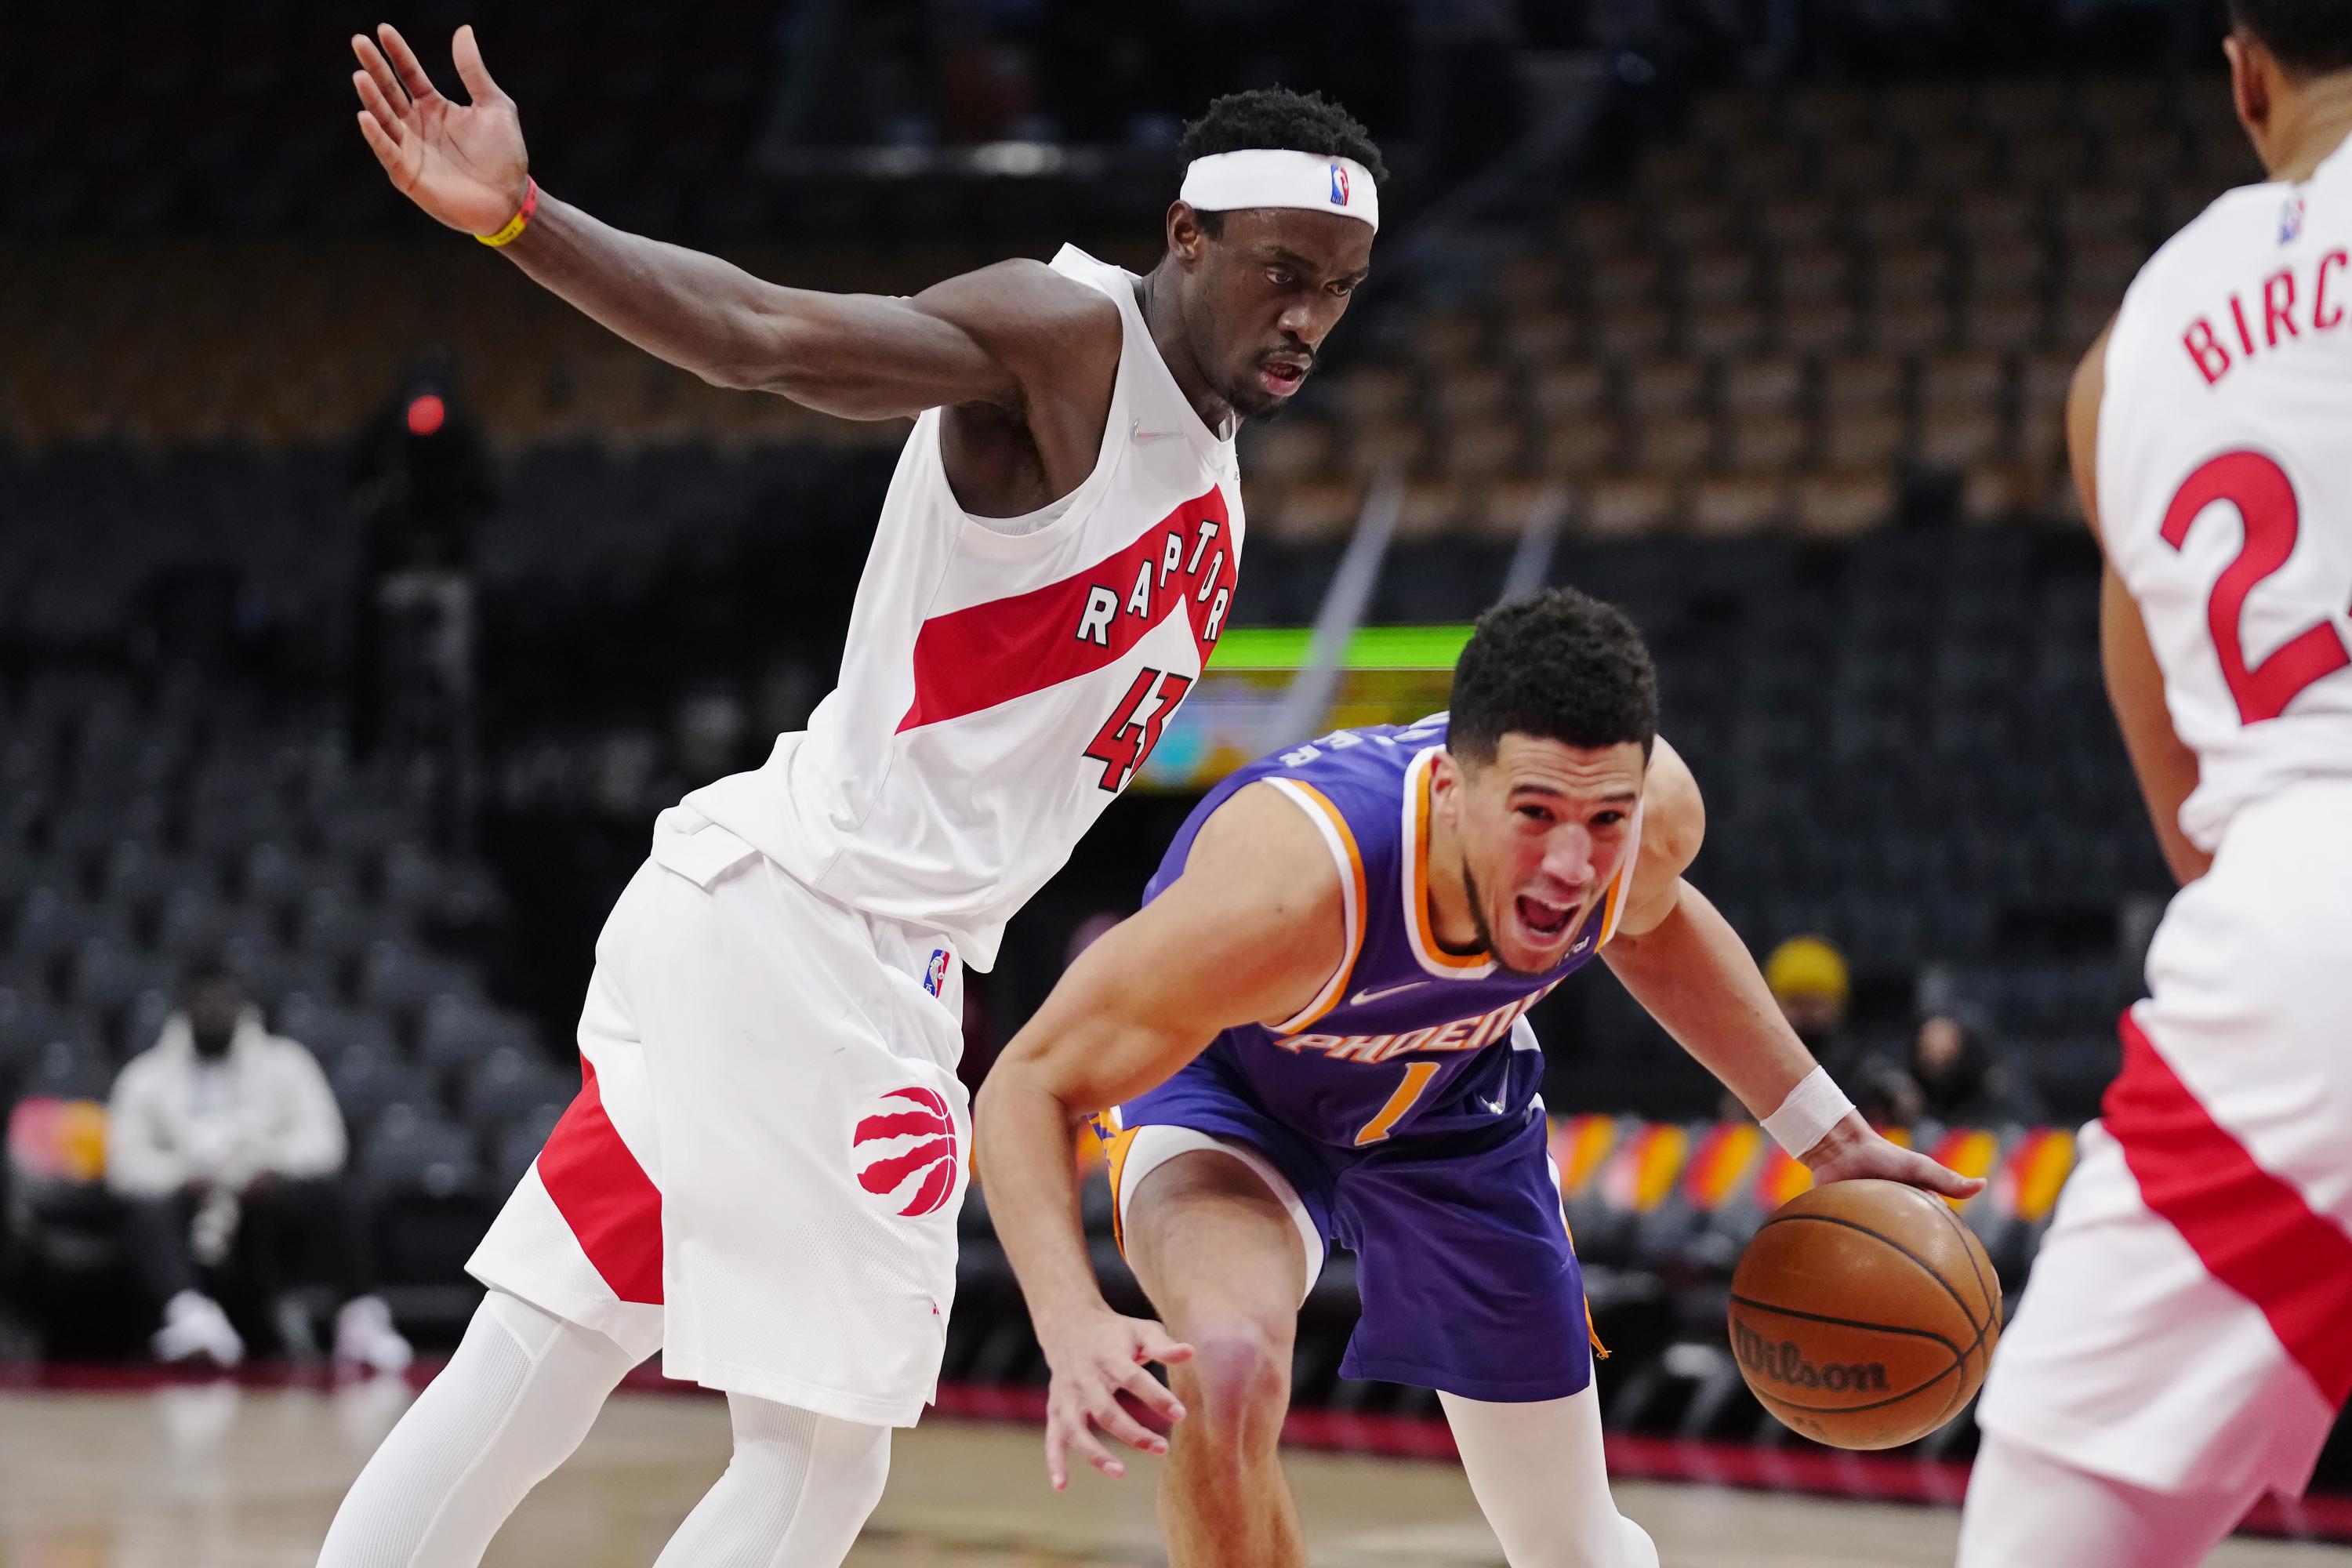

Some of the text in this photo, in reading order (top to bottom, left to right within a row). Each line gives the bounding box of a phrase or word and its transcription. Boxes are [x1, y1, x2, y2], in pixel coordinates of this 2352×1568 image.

[2183, 249, 2352, 384] BIRC
[1075, 520, 1229, 648] RAPTOR
[2159, 451, 2352, 726] 2
[1273, 975, 1565, 1064] PHOENI
[1354, 1062, 1441, 1146] 1
[1734, 1317, 1891, 1393] Wilson
